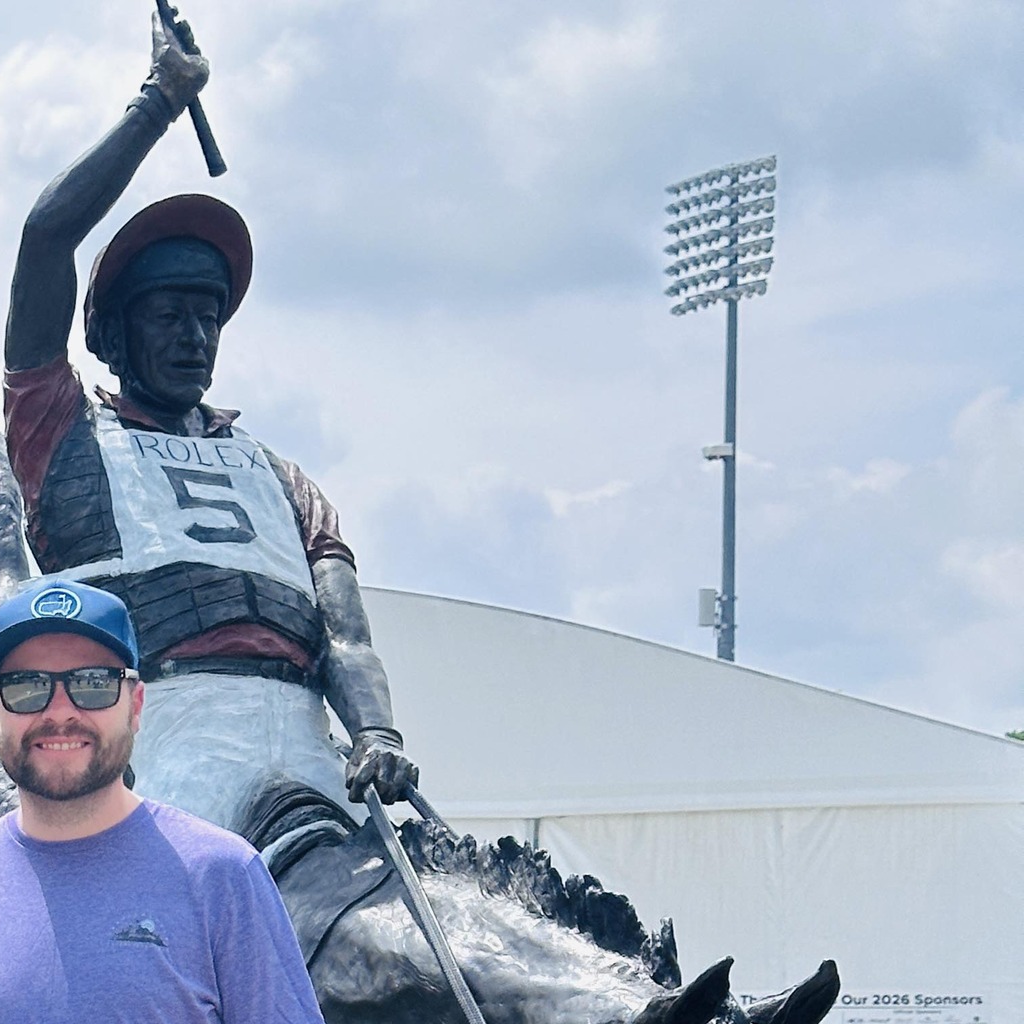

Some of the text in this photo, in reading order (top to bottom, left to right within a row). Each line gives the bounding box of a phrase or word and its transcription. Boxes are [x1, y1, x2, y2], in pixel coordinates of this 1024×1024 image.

[132, 434, 267, 470] ROLEX
[161, 465, 257, 543] 5
[841, 994, 983, 1007] Our 2026 Sponsors
